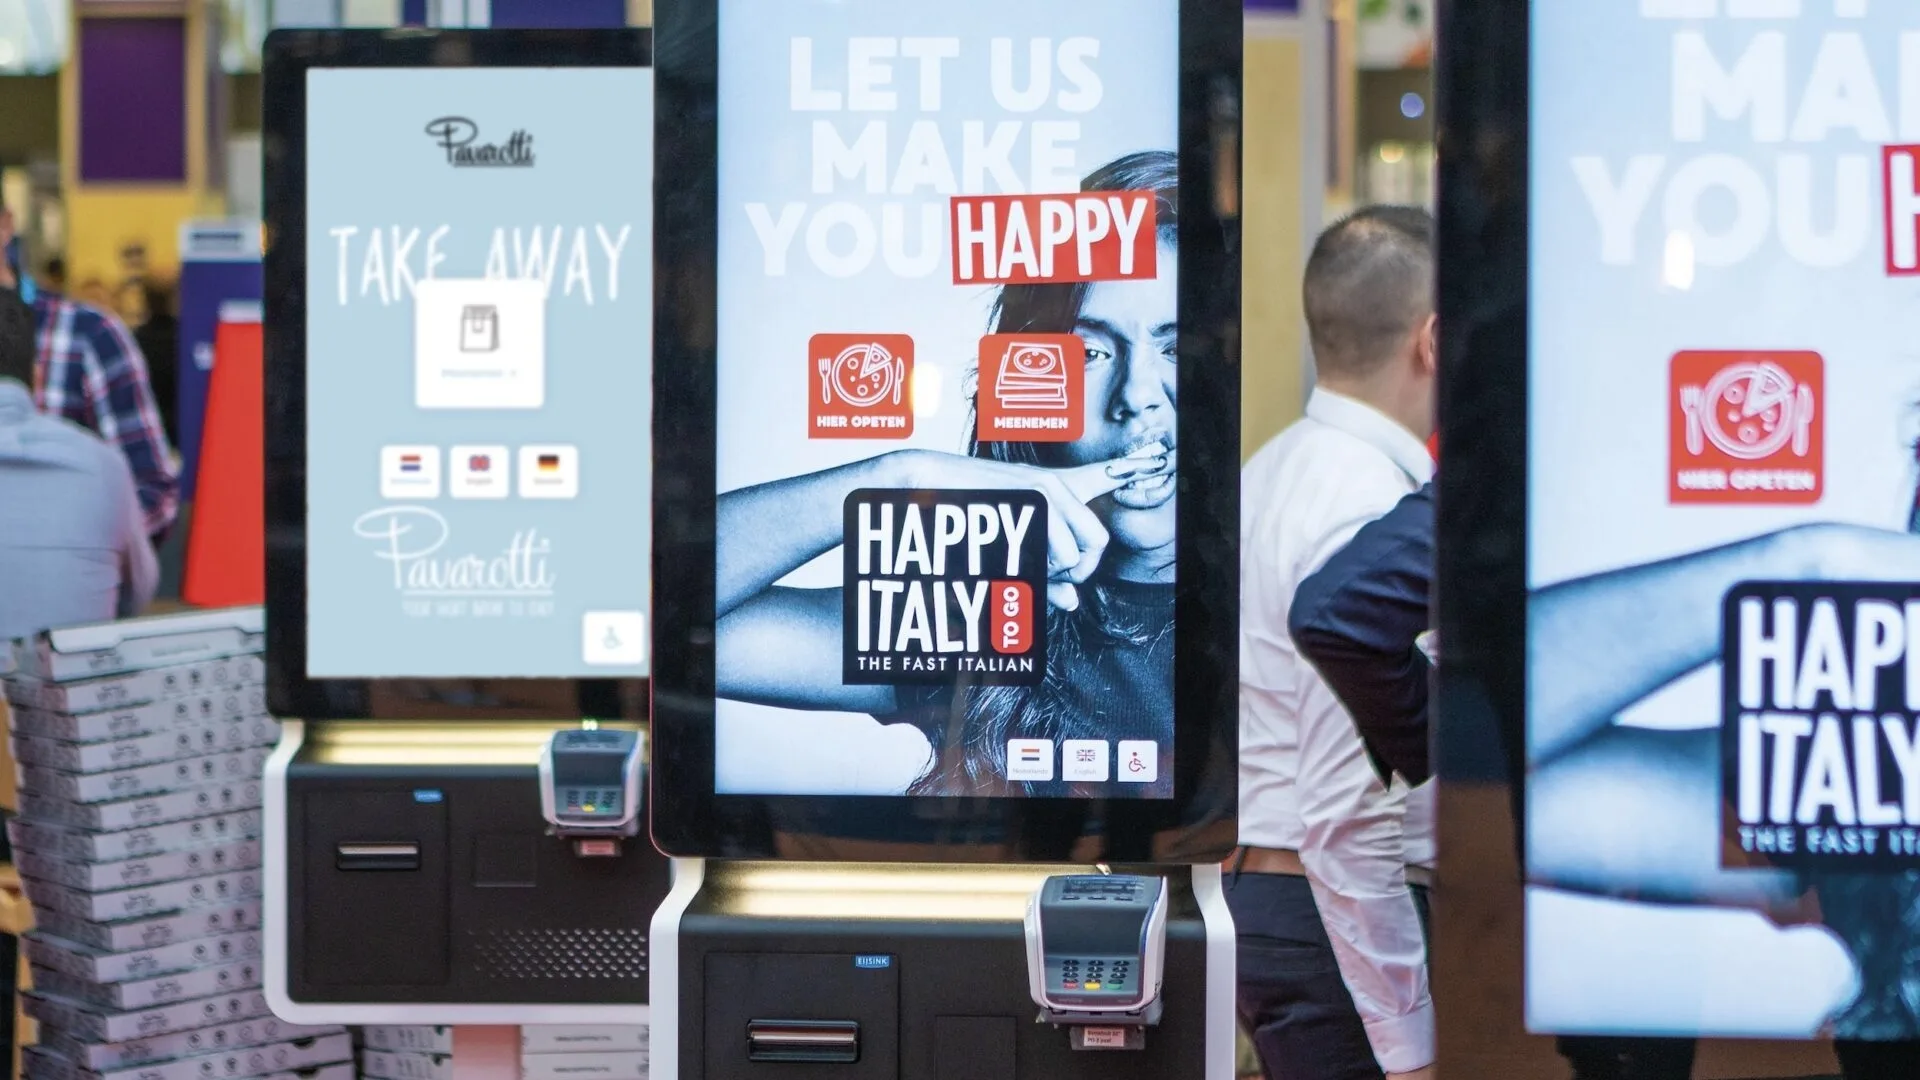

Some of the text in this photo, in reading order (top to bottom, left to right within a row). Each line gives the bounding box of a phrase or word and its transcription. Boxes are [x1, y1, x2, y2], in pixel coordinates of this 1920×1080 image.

[790, 37, 1104, 112] LET US
[425, 116, 536, 166] Pavarotti
[812, 120, 1081, 194] MAKE
[744, 196, 1148, 279] YOU HAPPY
[1568, 153, 1870, 267] YOU
[329, 223, 632, 305] TAKE AWAY
[816, 415, 906, 428] HIER OPETEN
[994, 416, 1069, 430] MEENEMEN
[353, 505, 556, 590] Pavarotti
[858, 502, 1036, 577] HAPPY
[857, 579, 990, 653] ITALY
[1002, 586, 1020, 649] TO GO
[858, 657, 1034, 672] THE FAST ITALIAN
[1738, 826, 1797, 853] THE
[1806, 826, 1880, 854] FAST
